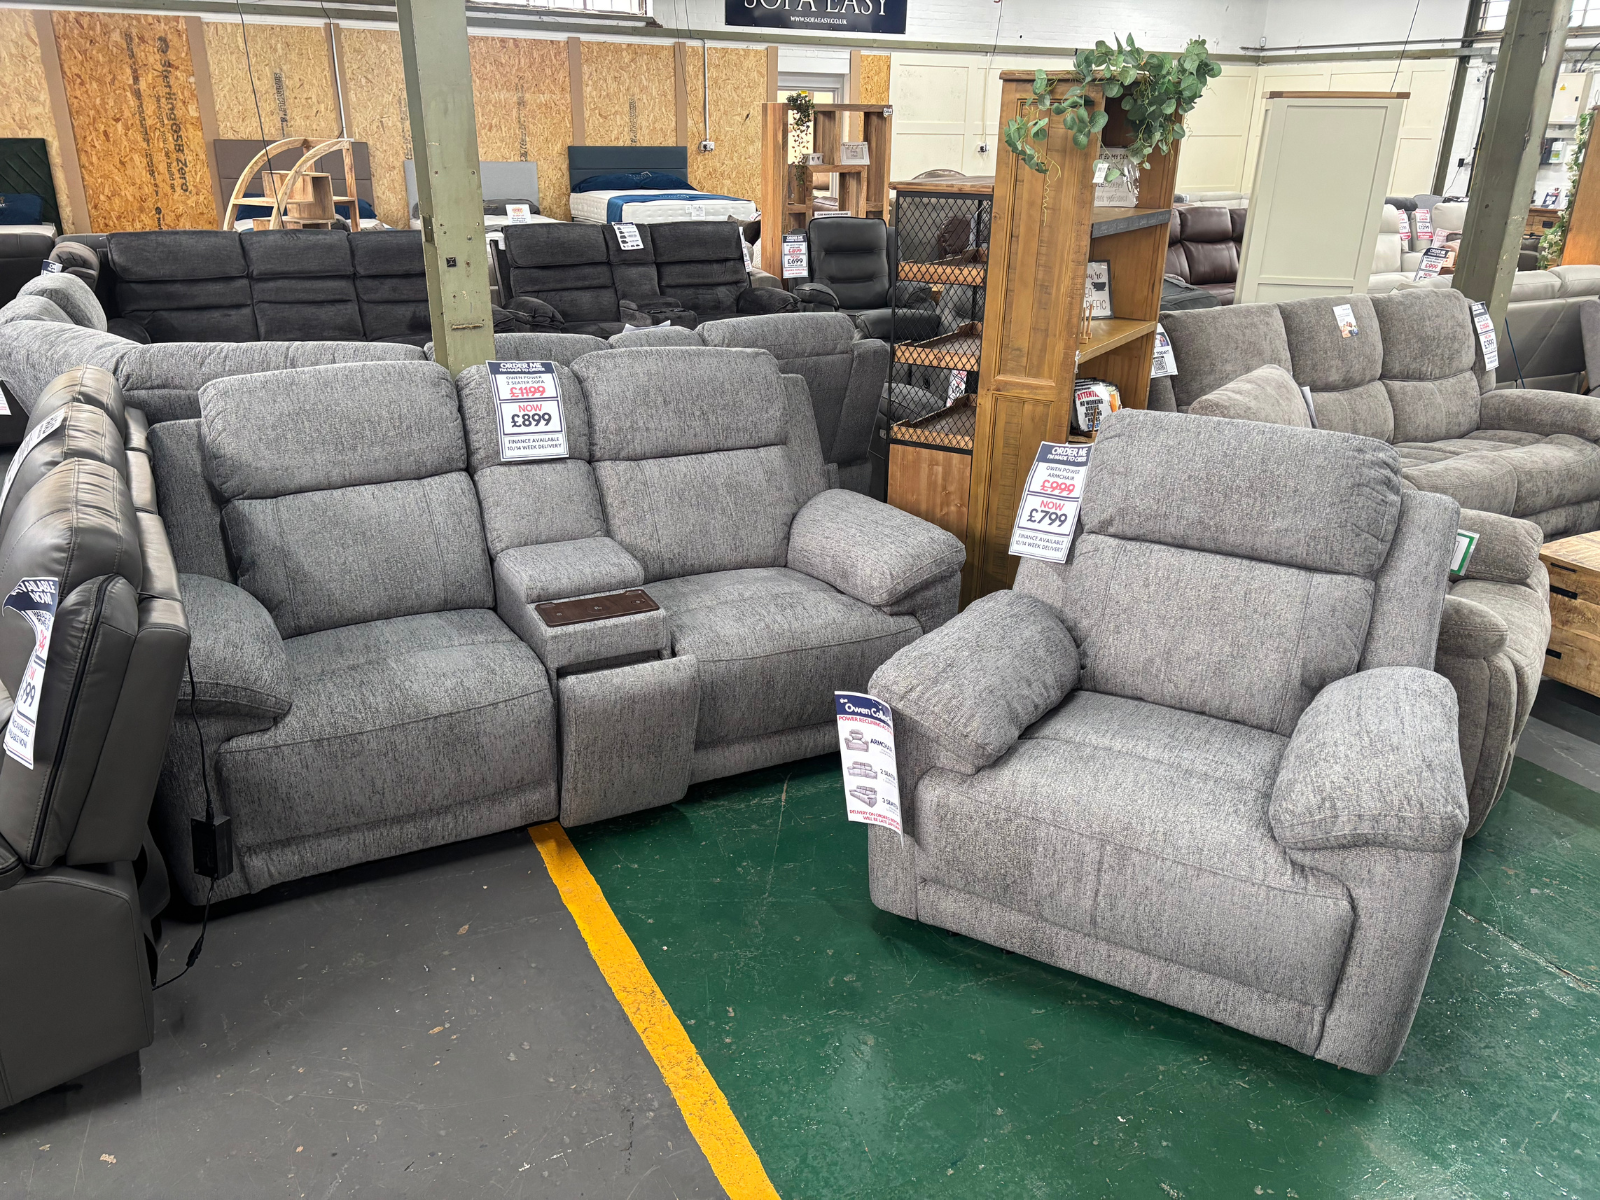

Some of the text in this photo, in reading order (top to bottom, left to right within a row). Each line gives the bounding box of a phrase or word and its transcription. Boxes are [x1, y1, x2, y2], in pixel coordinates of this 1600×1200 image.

[509, 386, 546, 398] £1199
[1077, 391, 1100, 401] ATTENTI
[518, 404, 543, 413] NOW
[511, 412, 552, 428] £899
[1051, 447, 1089, 457] ORDER ME
[1047, 473, 1075, 481] ARMCHAIR
[1040, 479, 1076, 496] £999
[1040, 500, 1066, 511] NOW
[1027, 508, 1068, 528] £799
[10, 580, 56, 595] AVAILABLE
[845, 703, 871, 716] Owen
